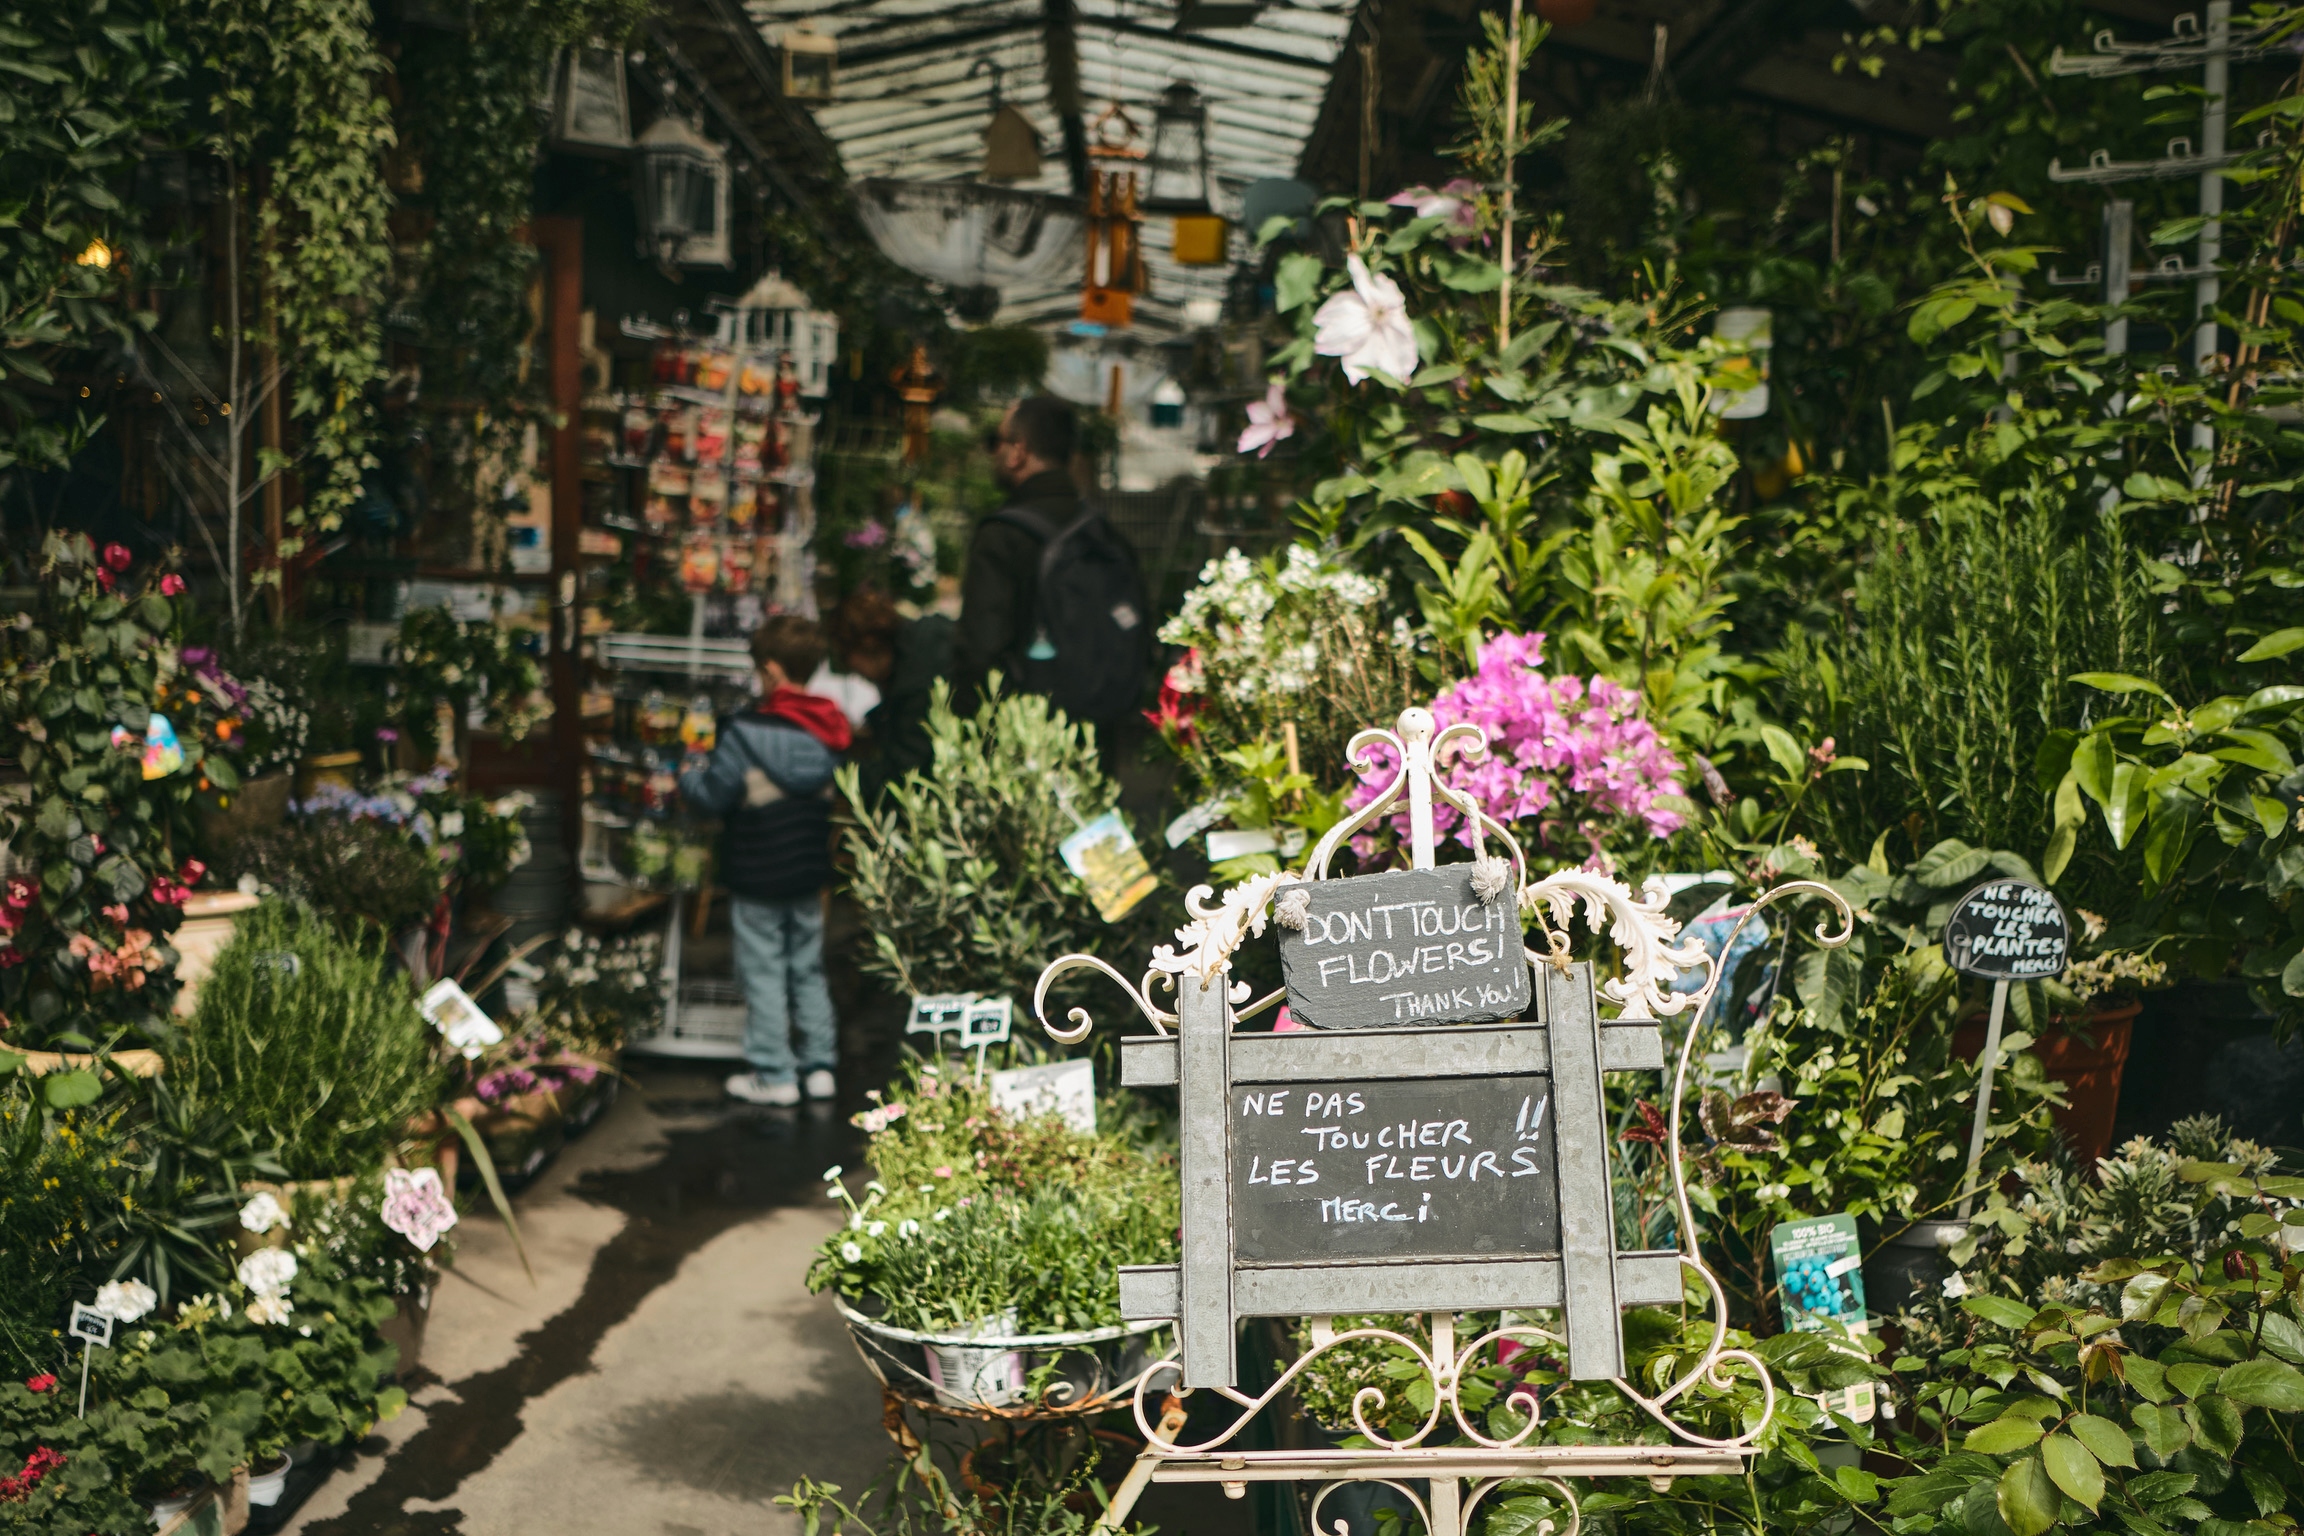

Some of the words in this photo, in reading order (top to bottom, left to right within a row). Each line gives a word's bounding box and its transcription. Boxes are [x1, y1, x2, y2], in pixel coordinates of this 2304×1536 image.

[1984, 885, 2013, 901] NE
[2020, 888, 2054, 906] PAS
[1304, 894, 1399, 946] DON'T
[1400, 901, 1505, 937] TOUCH
[1968, 901, 2061, 927] TOUCHER
[1993, 920, 2033, 940] LES
[1972, 934, 2065, 957] PLANTES
[1318, 934, 1504, 988] FLOWERS!
[1379, 987, 1473, 1019] THANK
[1243, 1091, 1289, 1116] NE
[1305, 1092, 1366, 1118] PAS
[1301, 1119, 1472, 1151] TOUCHER
[1248, 1156, 1320, 1185] LES
[1365, 1147, 1540, 1185] FLEURS
